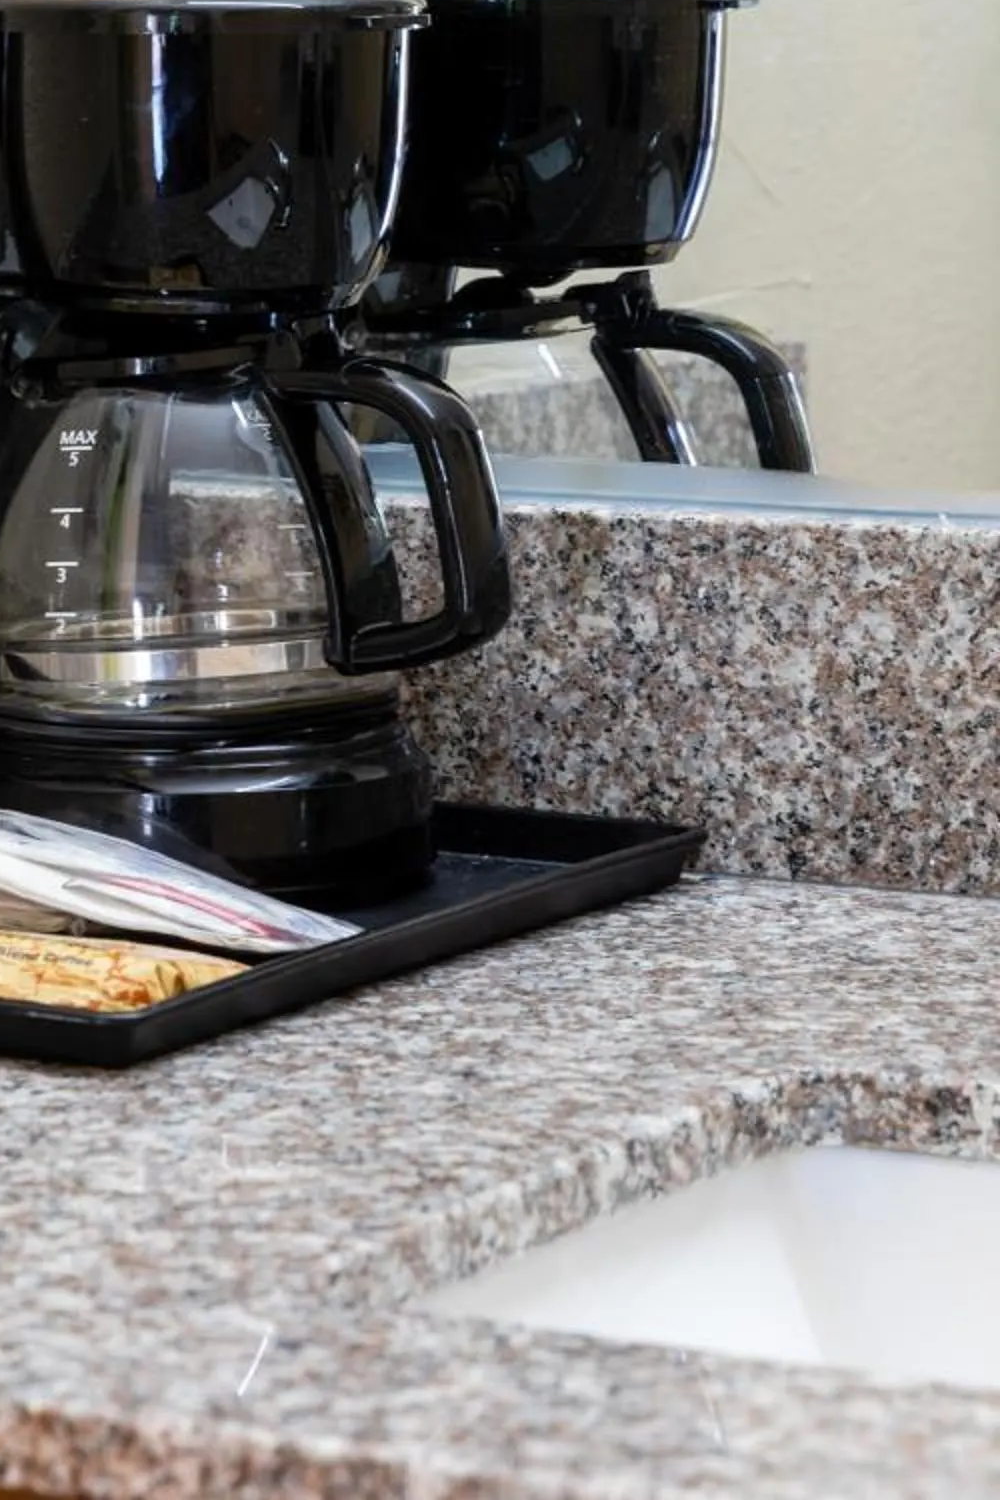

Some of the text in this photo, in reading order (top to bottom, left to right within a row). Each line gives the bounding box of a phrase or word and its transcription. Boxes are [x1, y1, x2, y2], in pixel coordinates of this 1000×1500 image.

[59, 429, 98, 445] MAX
[68, 451, 80, 467] 5
[60, 514, 71, 529] 4
[56, 567, 67, 583] 3
